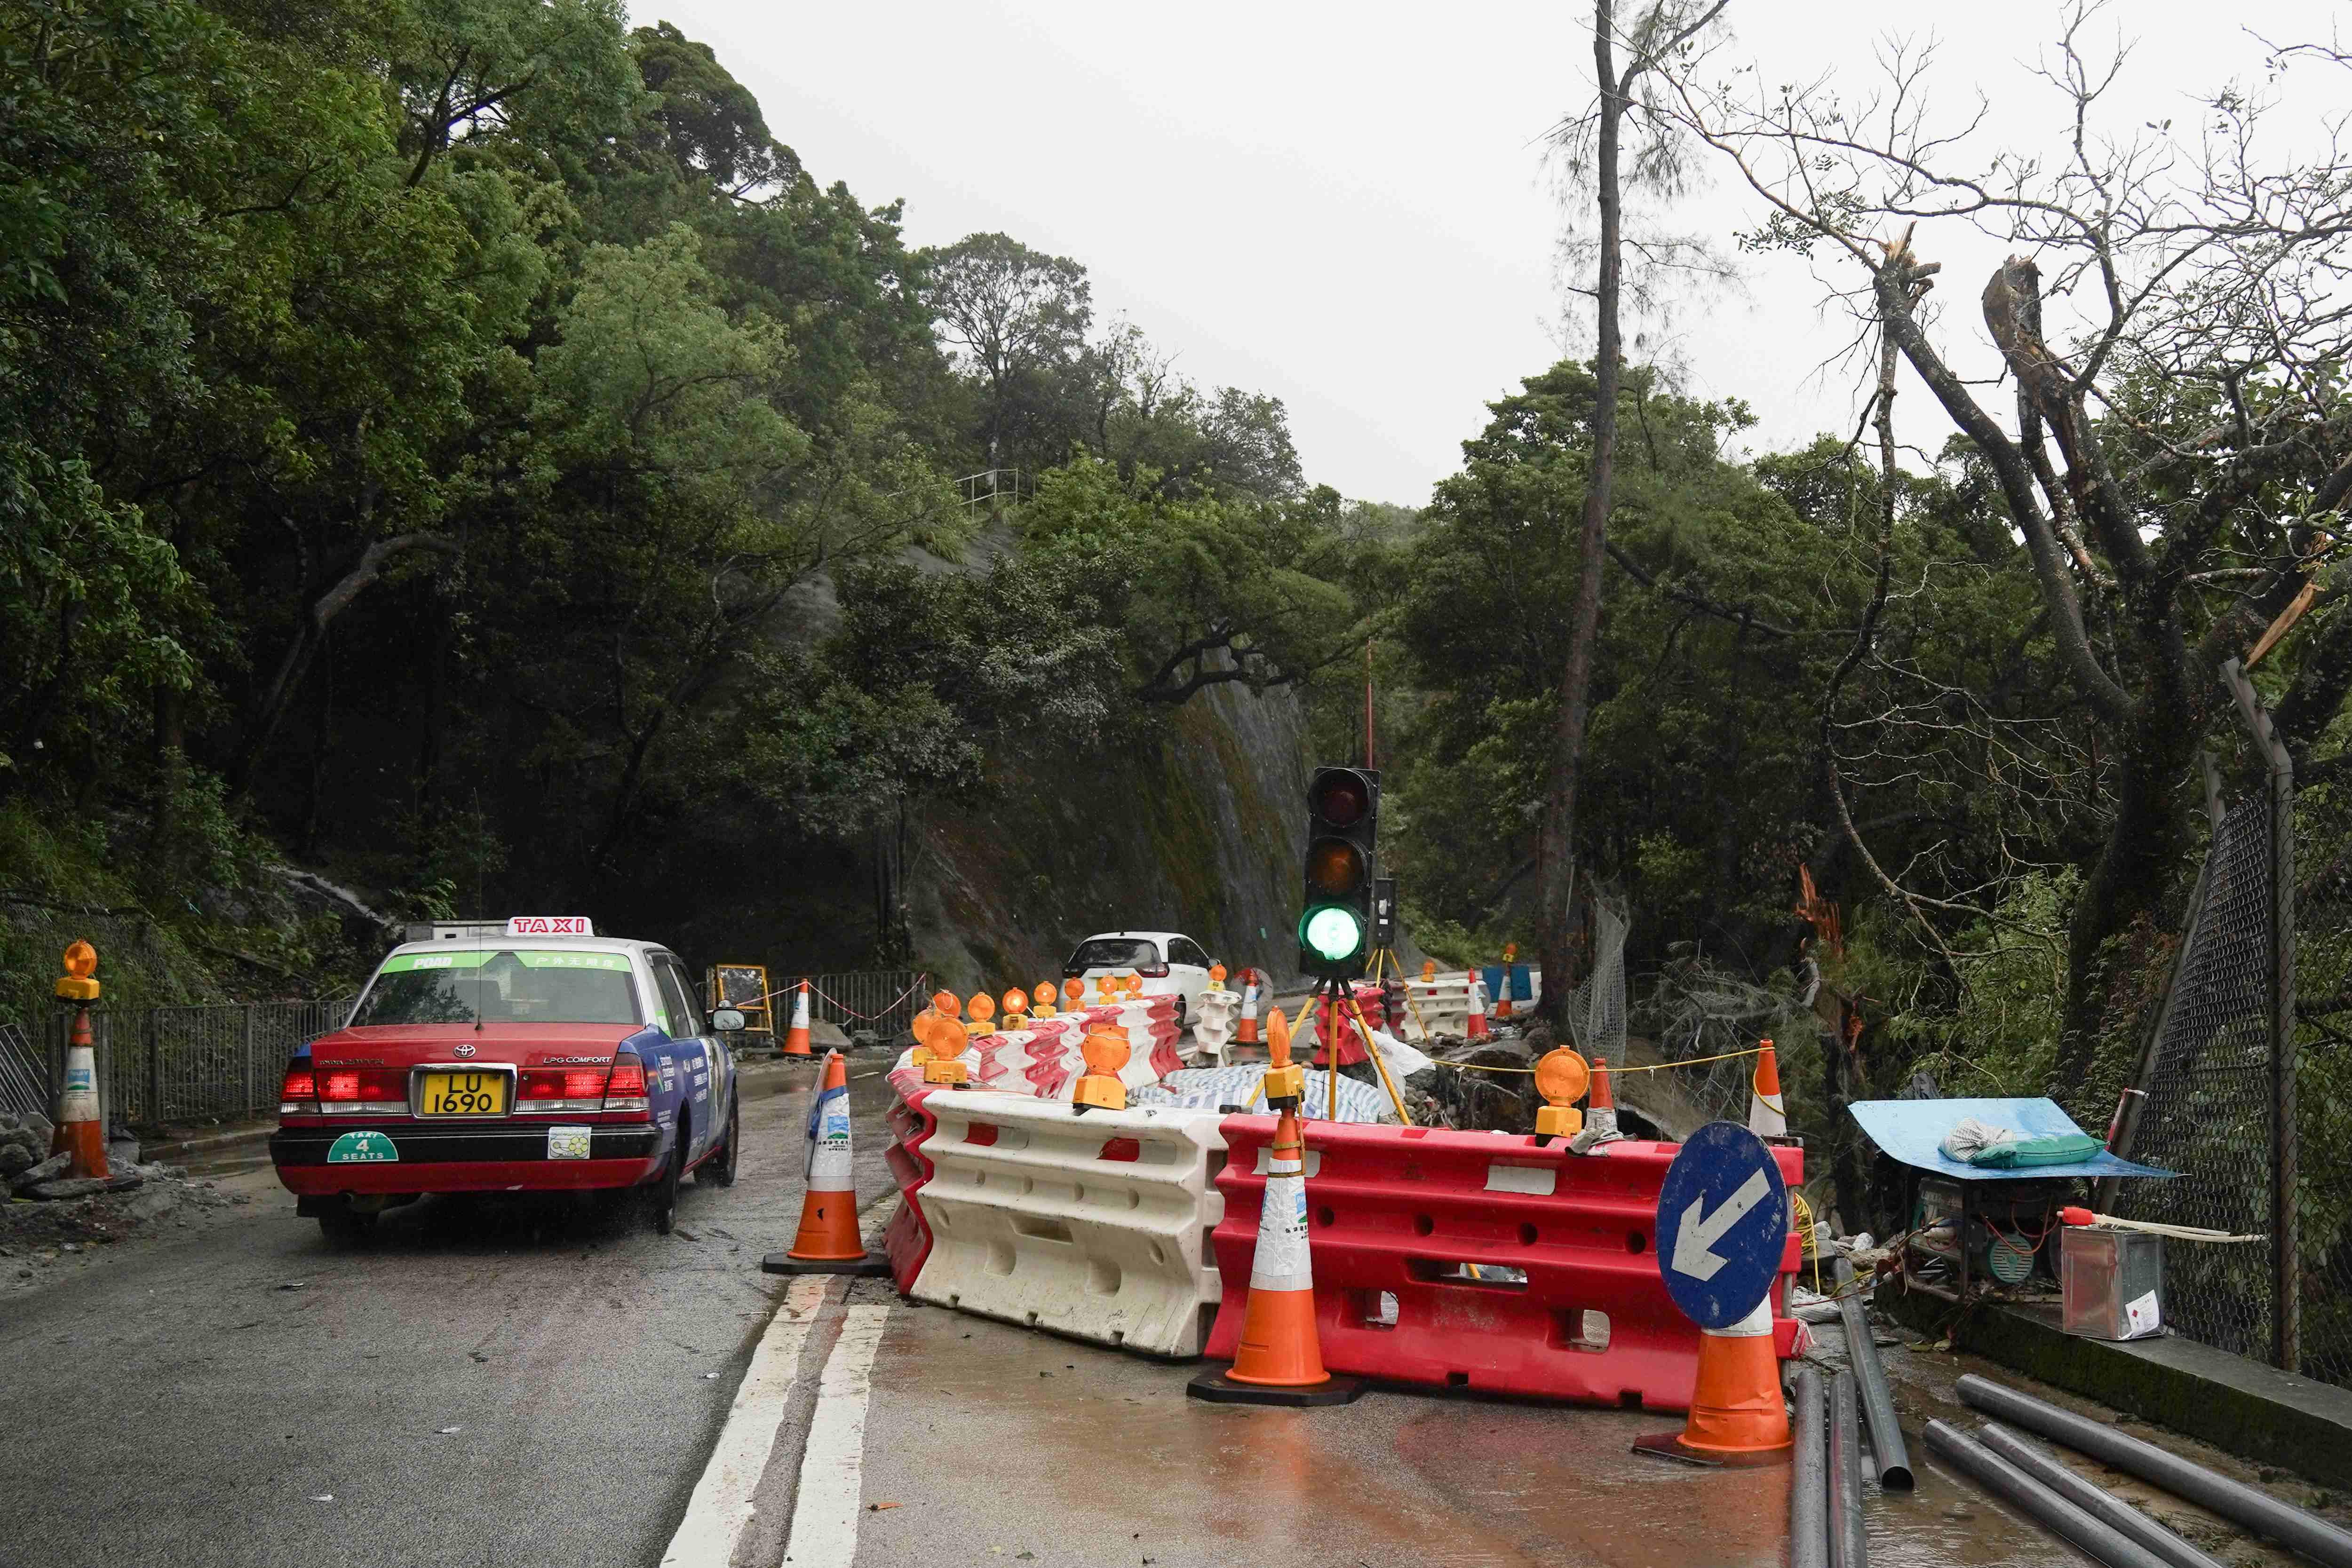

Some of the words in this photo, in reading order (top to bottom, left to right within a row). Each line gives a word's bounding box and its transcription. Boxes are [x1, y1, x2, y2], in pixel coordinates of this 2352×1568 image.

[514, 919, 584, 933] TAXI
[448, 1075, 481, 1094] LU
[434, 1093, 493, 1113] 1690
[356, 1139, 369, 1152] 4
